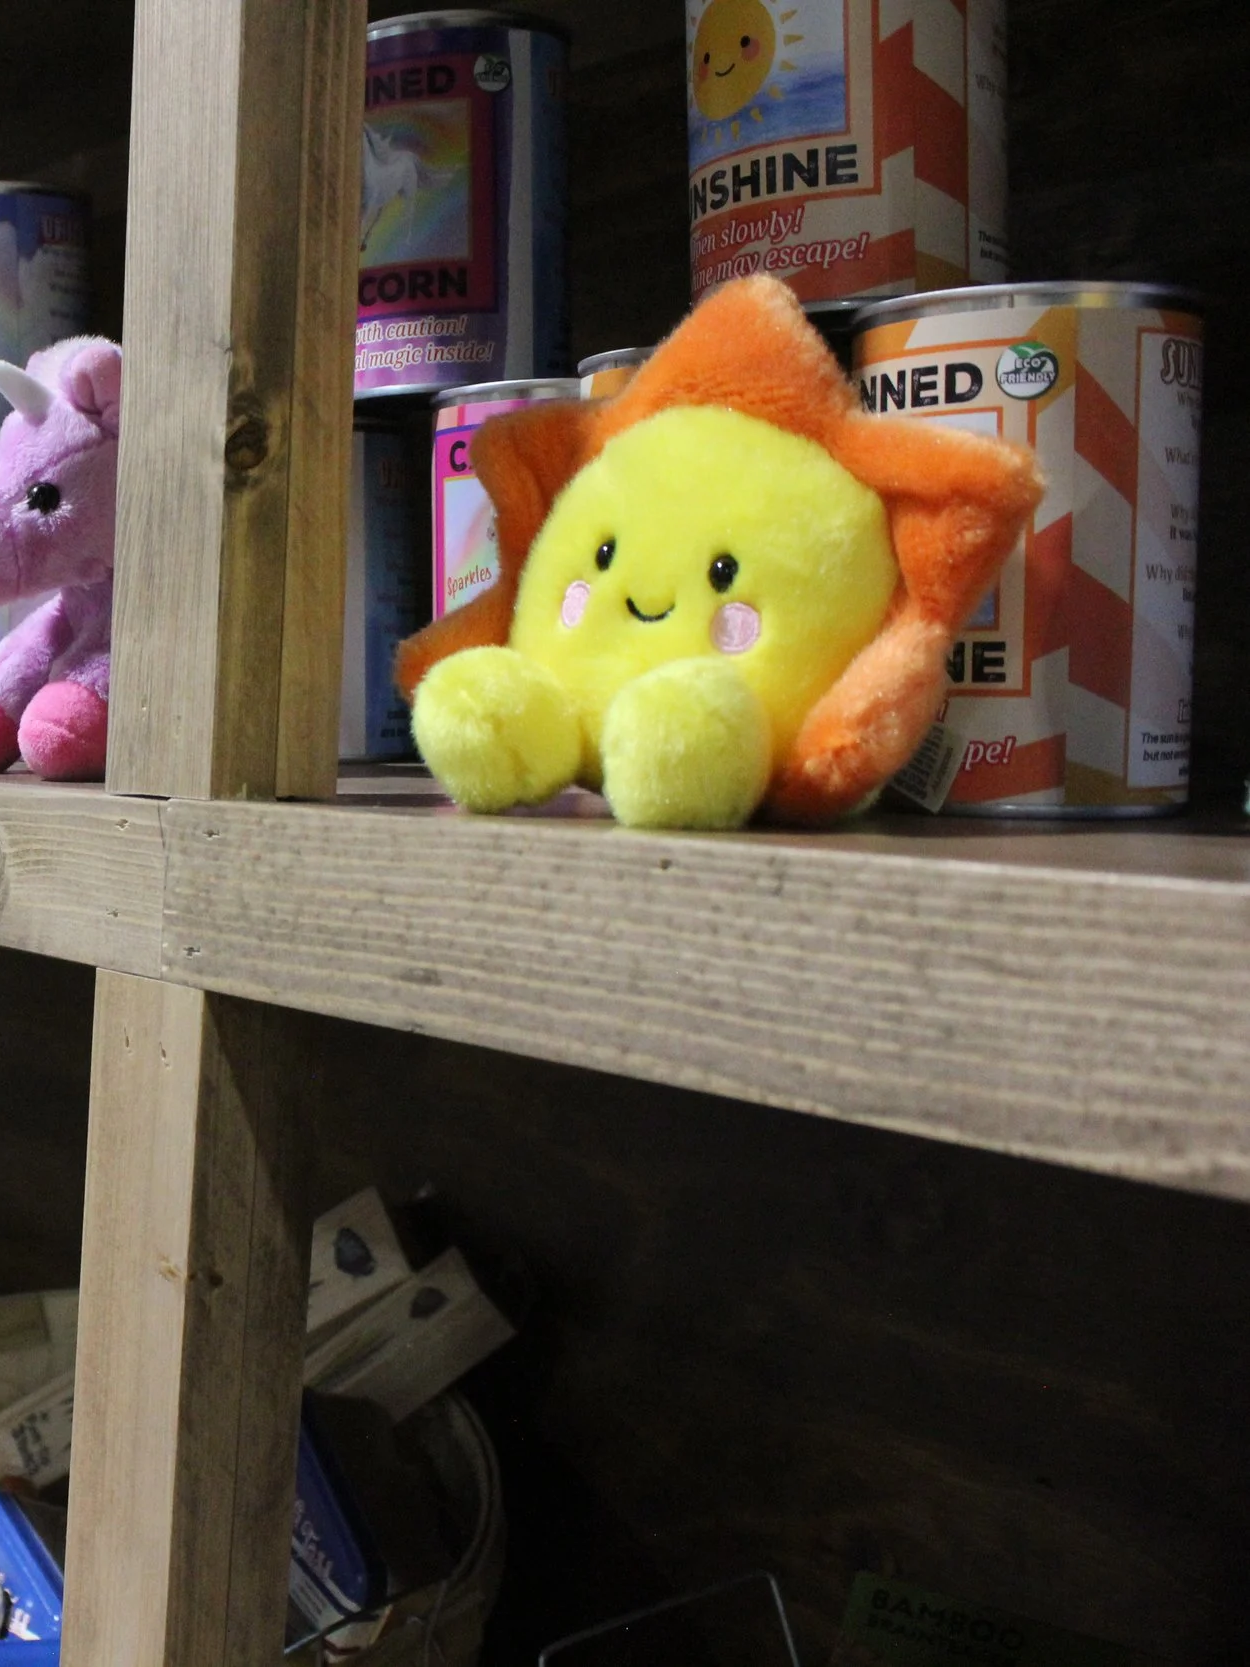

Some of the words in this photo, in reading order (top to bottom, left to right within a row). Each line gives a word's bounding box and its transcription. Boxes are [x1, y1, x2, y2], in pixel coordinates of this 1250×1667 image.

[366, 64, 456, 107] NED
[689, 144, 859, 221] NSHINE
[719, 206, 804, 245] slowly!
[716, 252, 760, 280] may
[765, 234, 869, 270] escape!
[358, 267, 468, 307] CORN
[385, 315, 468, 341] caution!
[368, 344, 424, 372] magic
[425, 342, 496, 366] inside!
[1014, 356, 1043, 369] ECO
[999, 371, 1057, 385] FRIENDLY
[447, 564, 492, 599] Sparkles
[963, 736, 1015, 772] pe!
